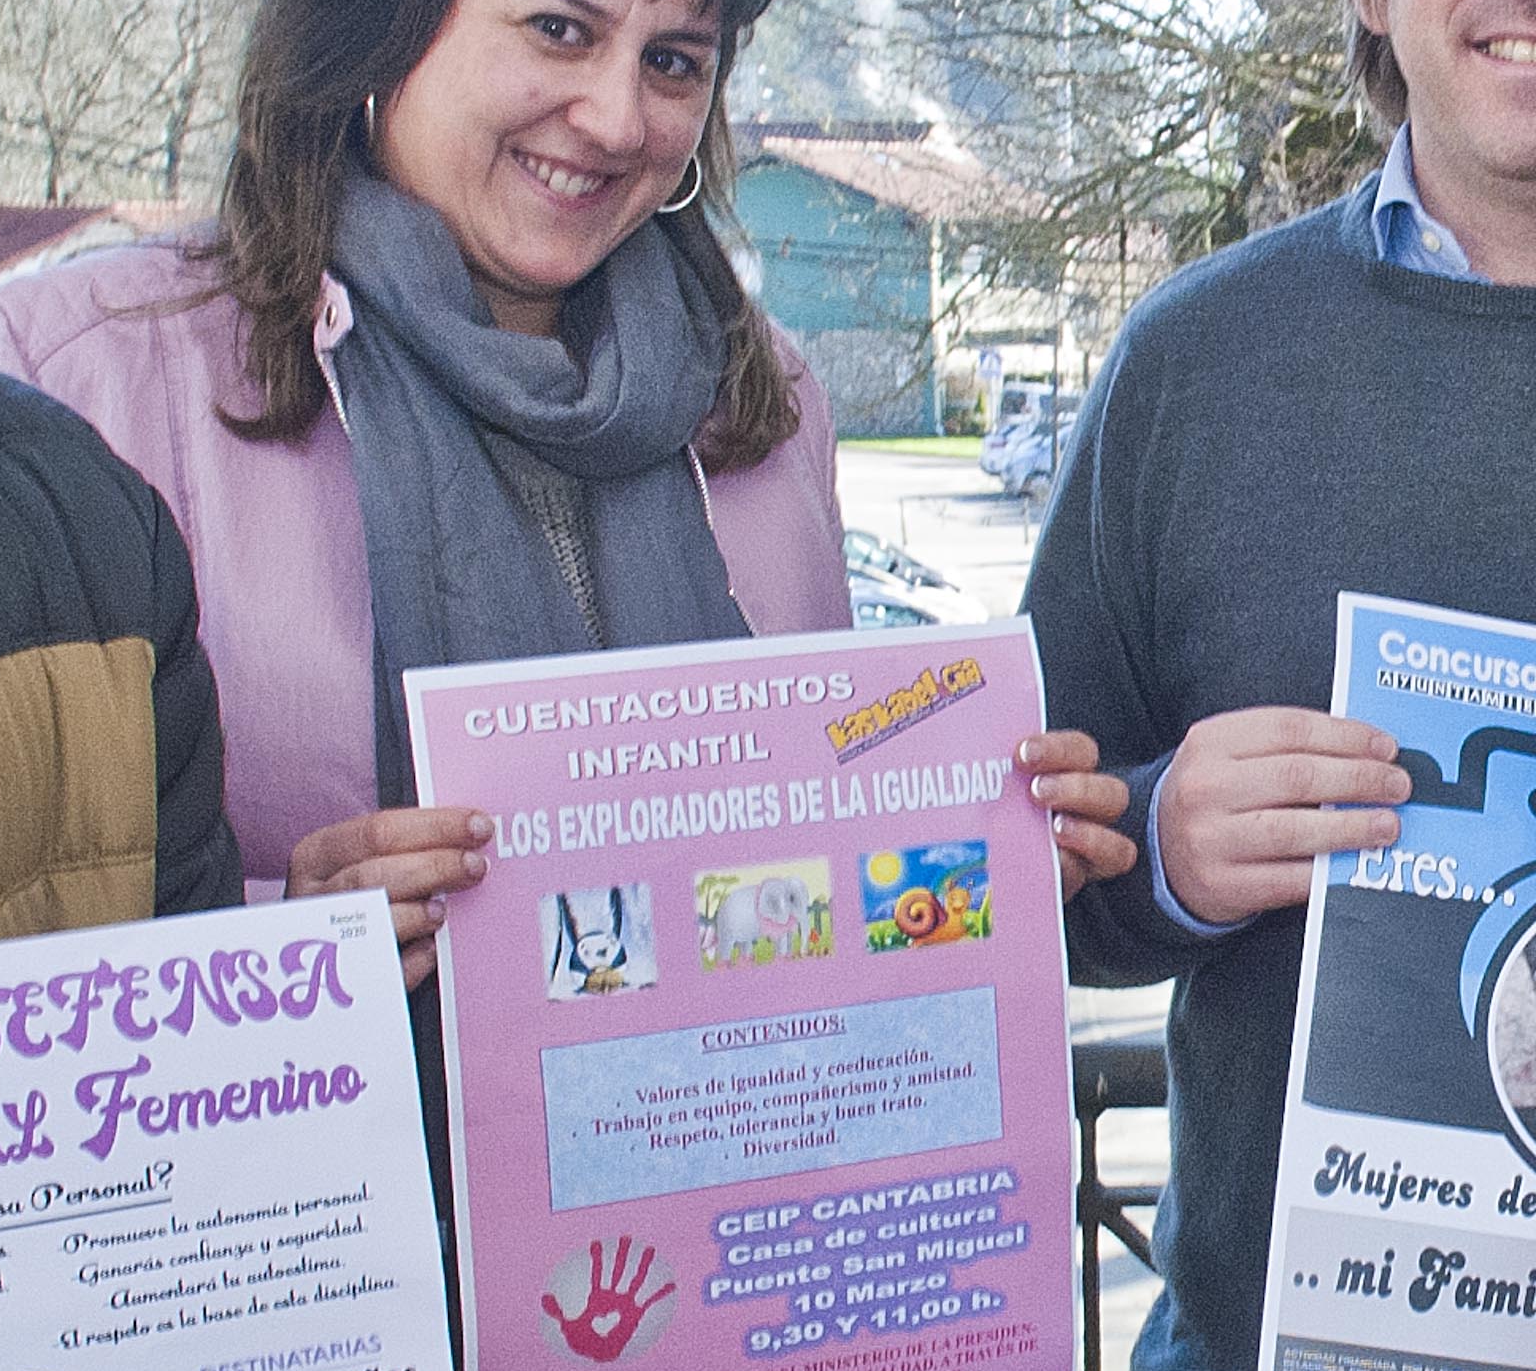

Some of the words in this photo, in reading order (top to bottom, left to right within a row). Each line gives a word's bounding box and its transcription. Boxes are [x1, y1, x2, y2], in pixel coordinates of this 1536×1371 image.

[465, 673, 854, 736] CUENTACUENTOS
[568, 732, 771, 778] INFANTIL
[558, 784, 780, 849] EXPLORADORES
[787, 778, 824, 823] DE
[830, 773, 867, 818] LA
[700, 1011, 848, 1053] CONTENIDOS:
[594, 1111, 662, 1135] Trabajo
[667, 1109, 687, 1124] en
[693, 1099, 757, 1122] equipo,
[762, 1079, 887, 1109] compañerismo
[892, 1075, 901, 1093] y
[907, 1061, 975, 1086] amistad.
[635, 1084, 699, 1104] Valores
[705, 1077, 724, 1095] de
[730, 1064, 805, 1094] igualdad
[812, 1065, 821, 1084] y
[827, 1048, 933, 1076] coeducación.
[75, 1056, 364, 1158] Femenino
[649, 1127, 724, 1150] Respeto,
[729, 1110, 815, 1137] tolerancia
[820, 1110, 829, 1127] y
[835, 1103, 875, 1120] buen
[881, 1094, 926, 1112] trato.
[743, 1127, 841, 1157] Diversidad.
[30, 1162, 173, 1208] Personal?
[718, 1206, 800, 1236] CEIP
[812, 1171, 1012, 1219] CANTABRIA
[1314, 1146, 1472, 1209] Mujeres
[710, 1264, 831, 1298] Puente
[843, 1251, 905, 1275] San
[917, 1226, 1024, 1261] Miguel
[727, 1237, 813, 1265] Casa
[824, 1227, 866, 1248] de
[877, 1206, 995, 1239] cultura
[794, 1289, 835, 1312] 10
[846, 1273, 946, 1304] Marzo
[1335, 1249, 1394, 1297] mi
[750, 1321, 823, 1350] 9,30
[835, 1314, 858, 1334] Y
[871, 1296, 960, 1327] 11,00
[971, 1291, 1000, 1310] h.
